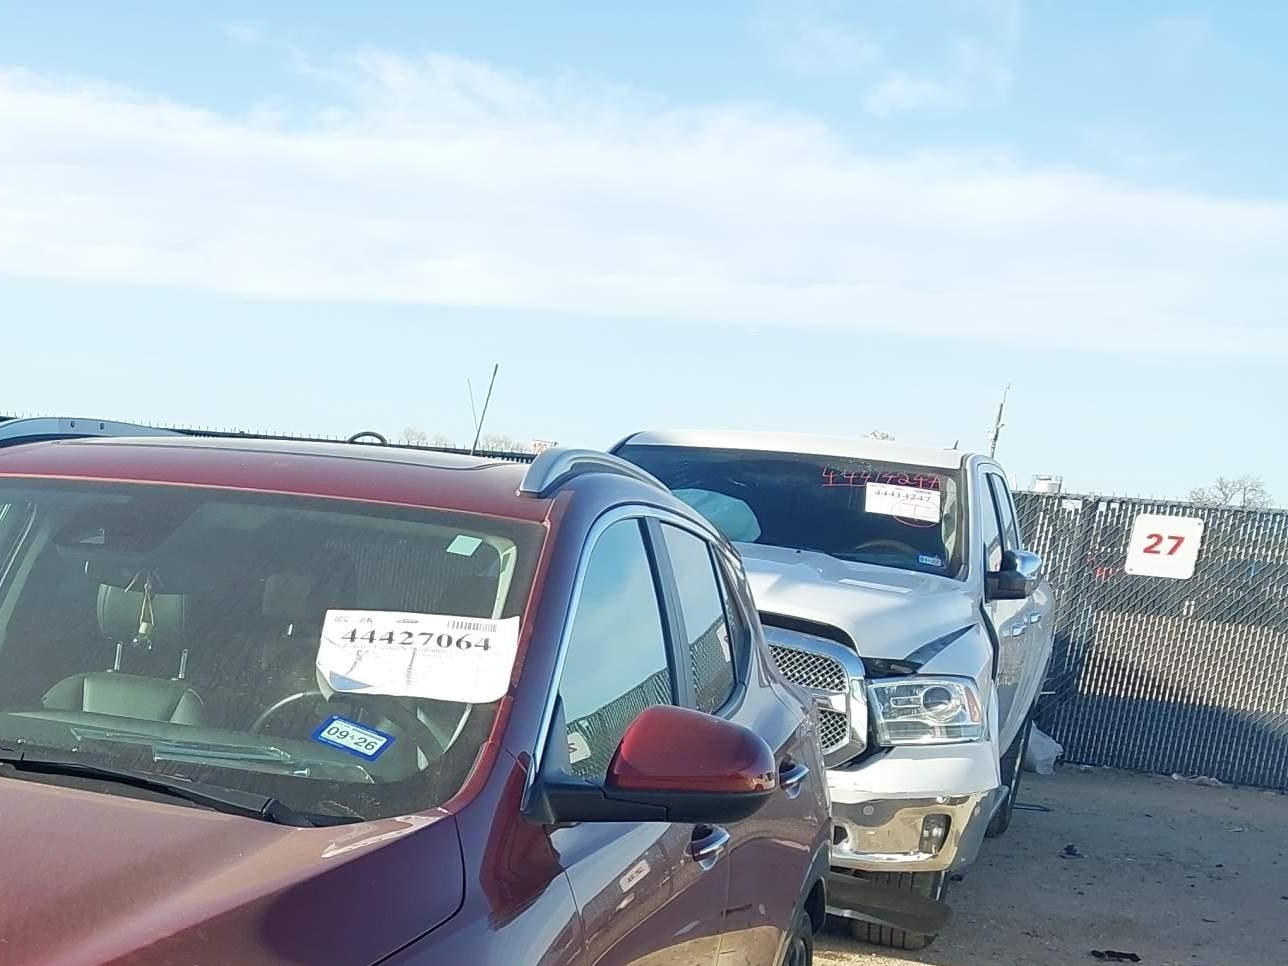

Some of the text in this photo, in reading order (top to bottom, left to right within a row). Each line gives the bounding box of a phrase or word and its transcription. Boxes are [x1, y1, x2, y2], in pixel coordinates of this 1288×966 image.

[1143, 533, 1186, 556] 27
[341, 628, 493, 651] 44427064
[326, 726, 378, 751] 09 26
